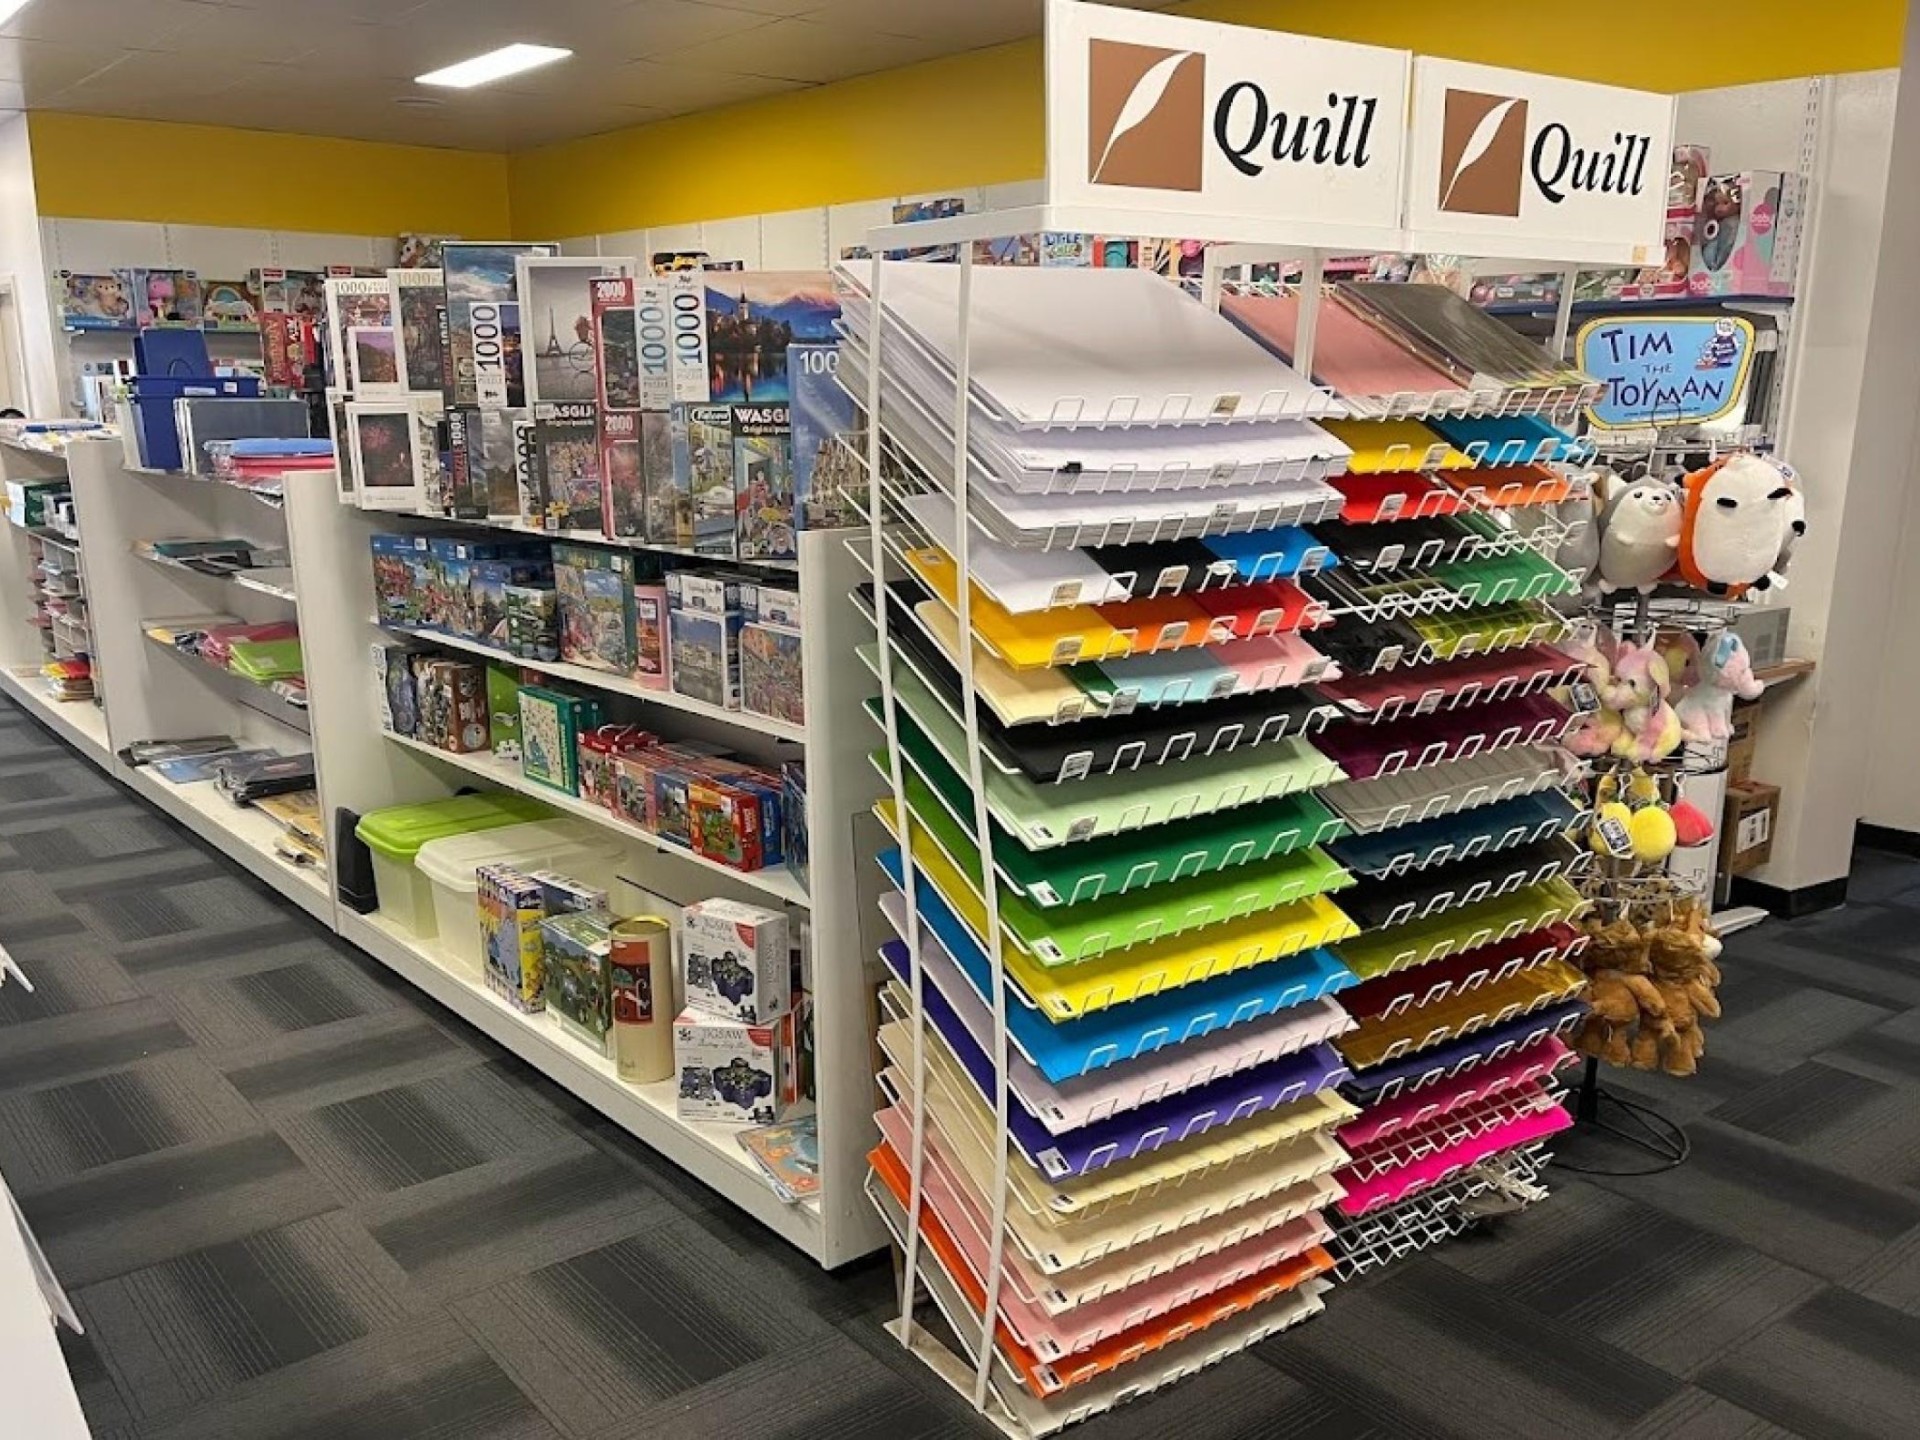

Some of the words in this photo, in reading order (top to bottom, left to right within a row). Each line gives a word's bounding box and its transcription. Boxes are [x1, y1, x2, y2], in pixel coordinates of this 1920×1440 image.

[1213, 80, 1379, 177] Quill
[1529, 122, 1652, 204] Quill
[597, 281, 626, 299] 2000
[471, 305, 501, 372] 1000
[639, 306, 668, 375] 1000
[673, 294, 701, 366] 1000
[1600, 328, 1674, 364] TIM
[799, 350, 840, 375] 100
[1642, 362, 1673, 375] THE
[1607, 375, 1724, 407] TOYMAN
[551, 405, 592, 418] ASGIJ
[604, 414, 634, 432] 2000
[735, 408, 790, 423] WASGI
